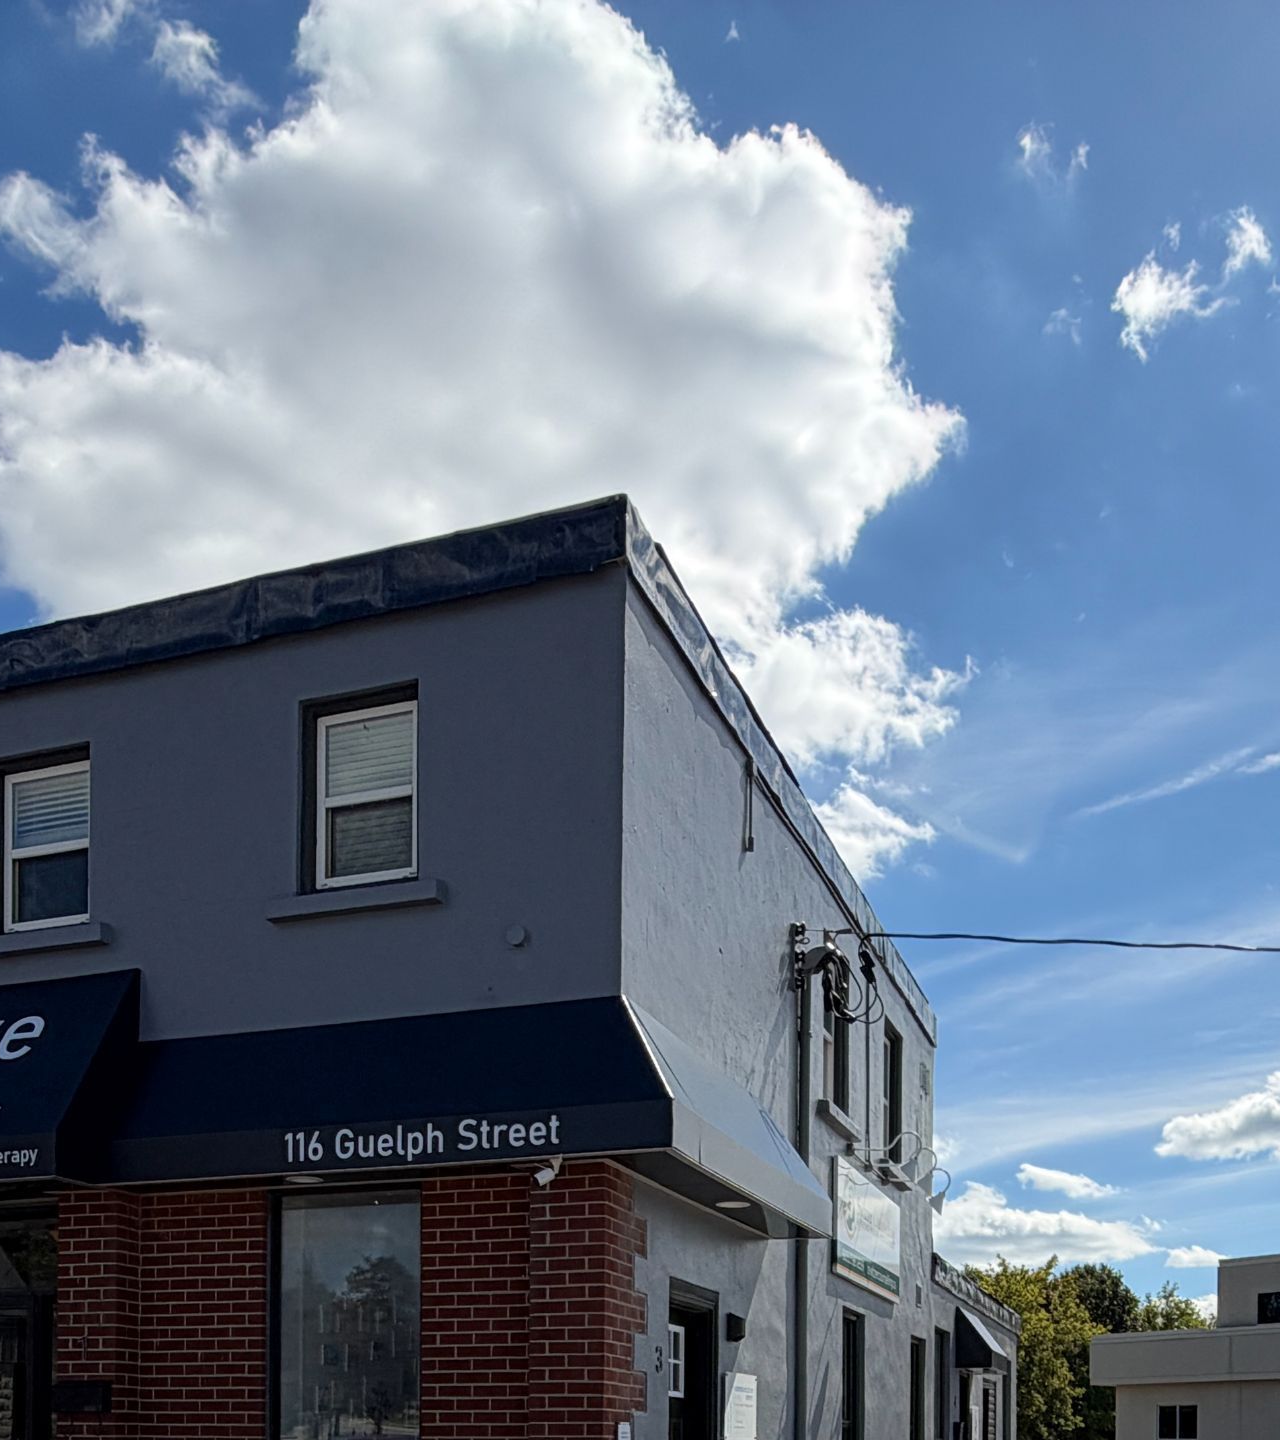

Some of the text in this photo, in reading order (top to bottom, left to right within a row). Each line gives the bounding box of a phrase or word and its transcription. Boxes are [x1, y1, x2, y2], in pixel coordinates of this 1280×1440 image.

[284, 1114, 560, 1163] 116 Guelph Street
[655, 1345, 663, 1374] 3
